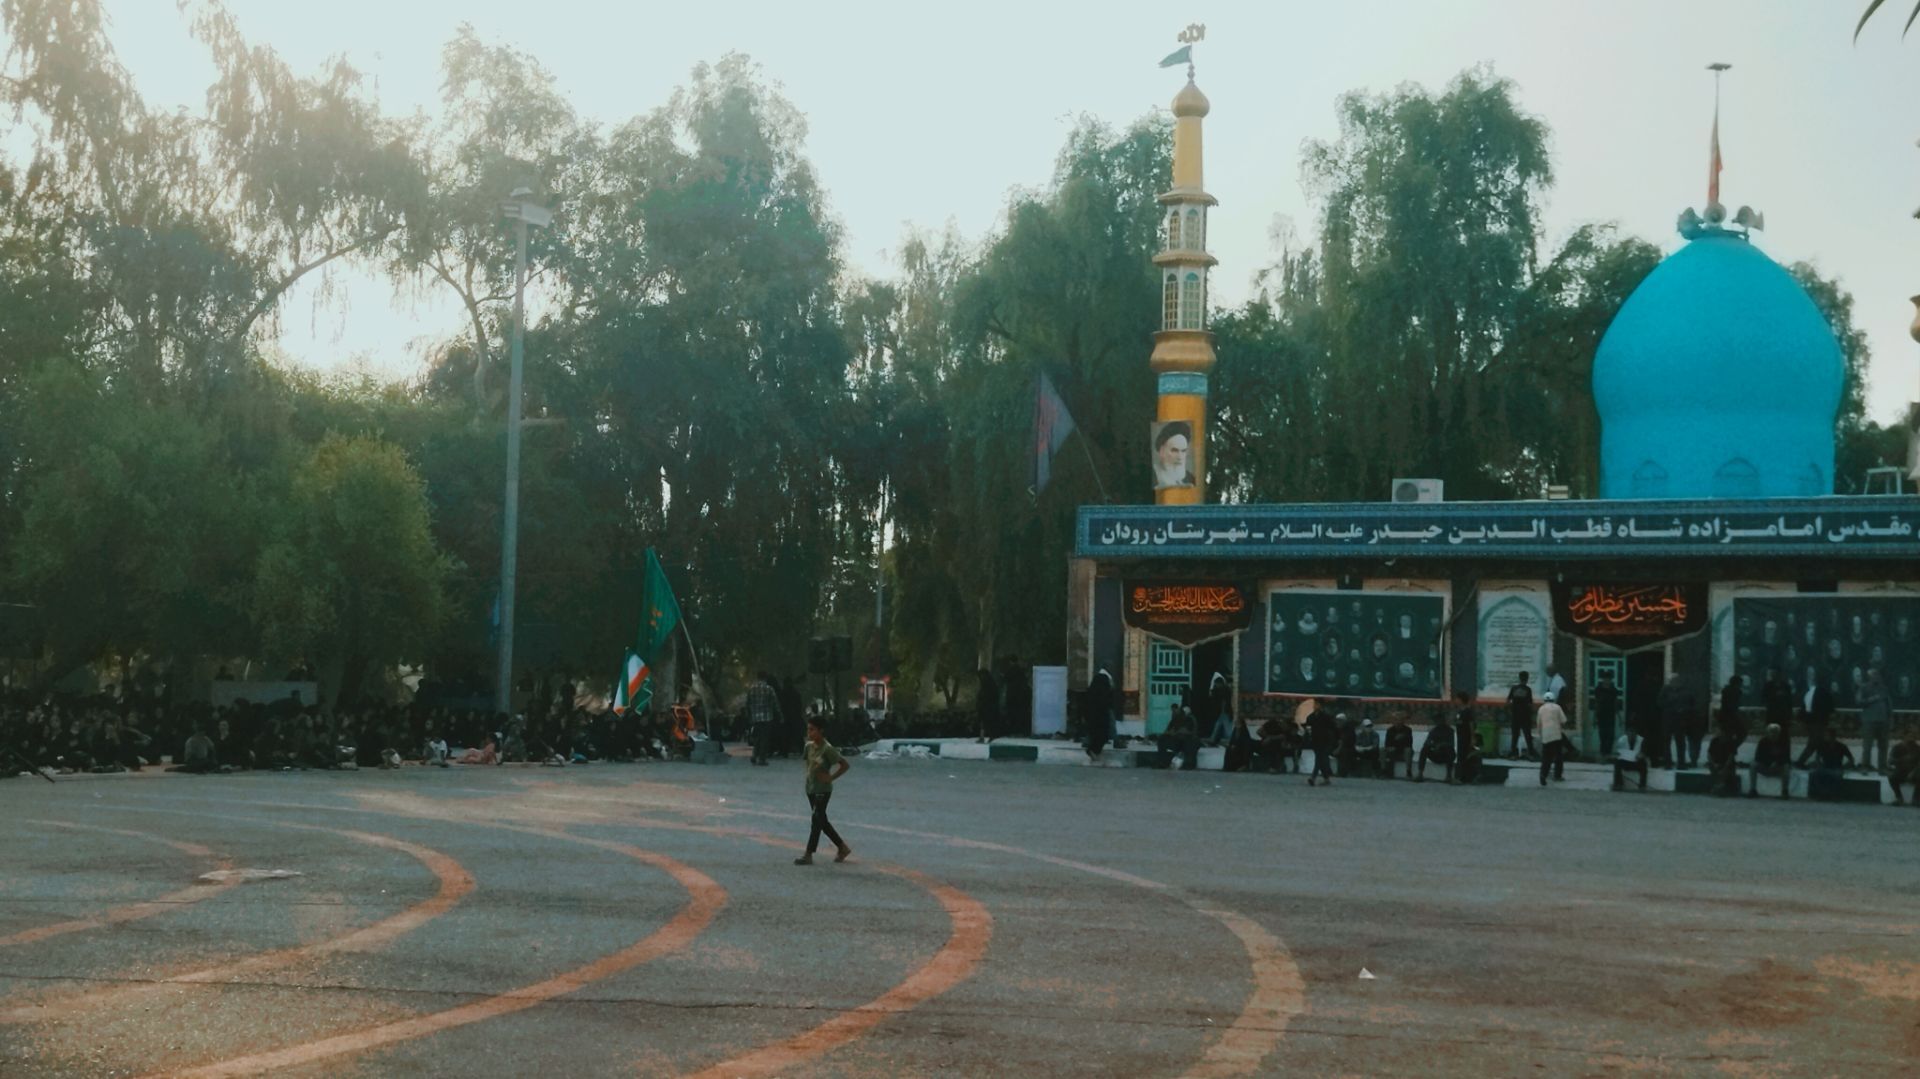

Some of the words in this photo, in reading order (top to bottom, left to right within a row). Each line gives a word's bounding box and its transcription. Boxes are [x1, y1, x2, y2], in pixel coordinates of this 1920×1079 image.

[1177, 23, 1206, 43] الله
[1101, 522, 1150, 545] رودان
[1153, 521, 1249, 545] شهرستان
[1270, 523, 1322, 543] السلام
[1325, 523, 1363, 542] علیه
[1367, 523, 1443, 545] حیدر
[1447, 518, 1546, 545] الدین
[1550, 517, 1613, 543] قطب
[1617, 517, 1683, 538] شاه
[1688, 516, 1822, 544] امامزاده
[1827, 515, 1912, 543] مقدس
